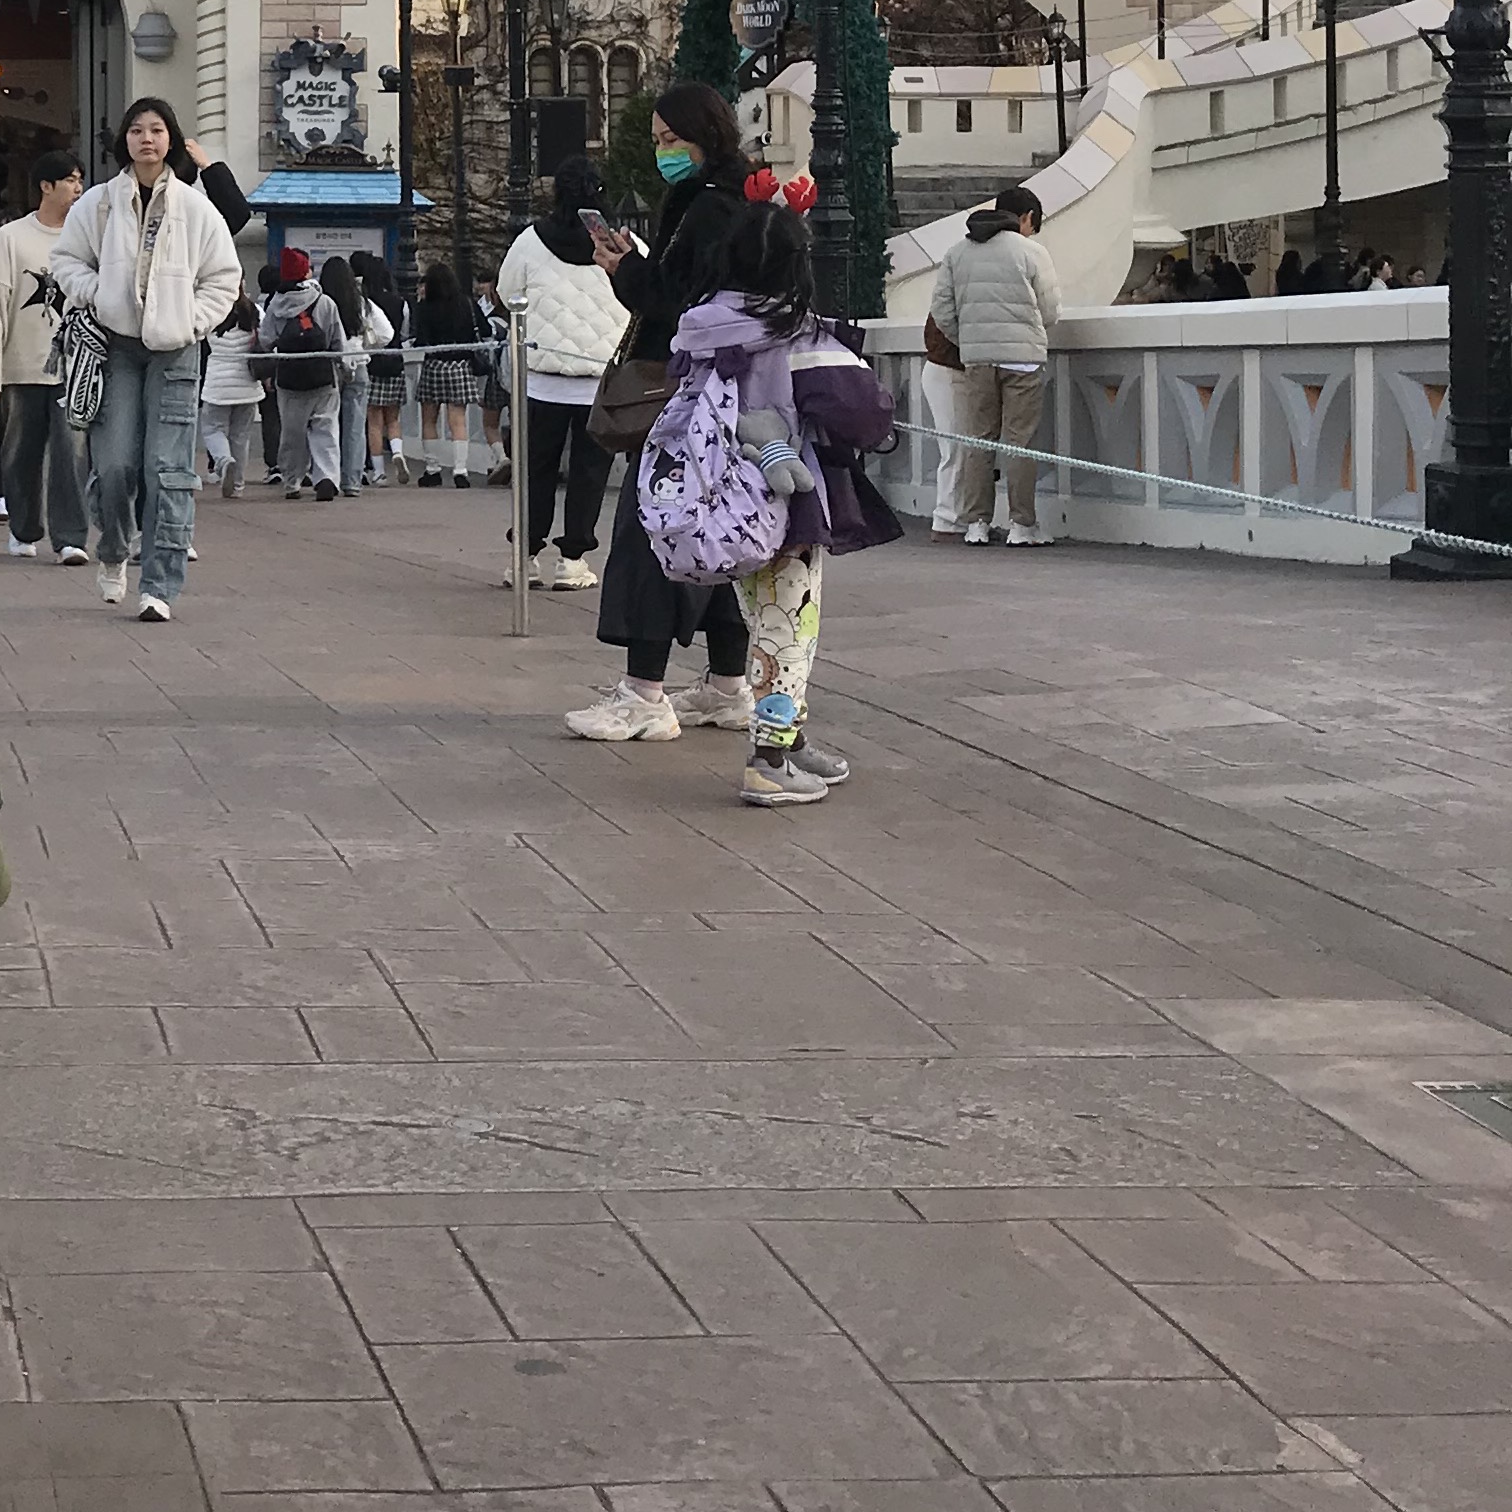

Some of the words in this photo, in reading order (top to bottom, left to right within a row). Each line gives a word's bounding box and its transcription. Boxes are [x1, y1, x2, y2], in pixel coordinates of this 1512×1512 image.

[735, 2, 757, 15] DARK
[756, 0, 780, 13] MOON
[742, 14, 772, 28] WORLD
[294, 80, 337, 93] MAGIC
[283, 93, 349, 108] CASTLE
